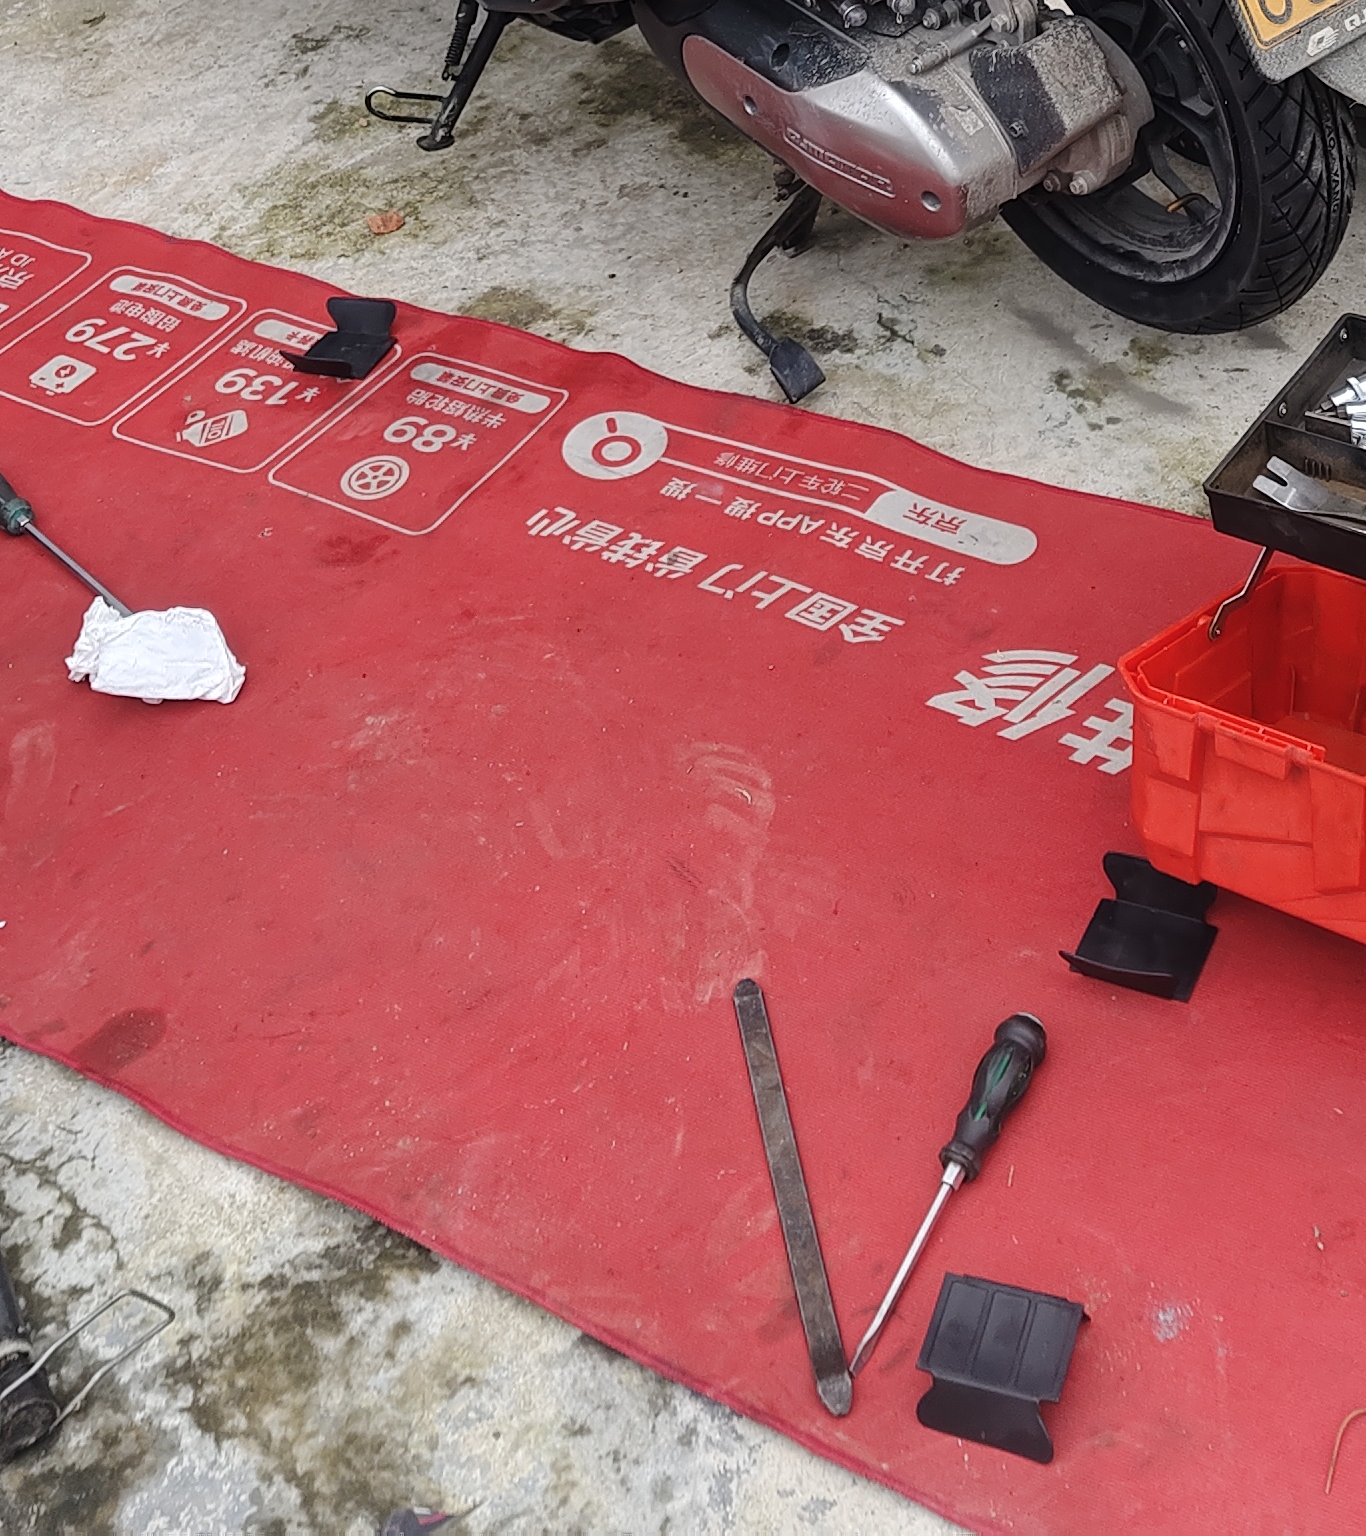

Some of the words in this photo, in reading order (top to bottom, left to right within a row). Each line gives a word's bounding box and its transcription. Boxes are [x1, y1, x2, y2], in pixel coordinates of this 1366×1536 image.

[12, 253, 36, 267] JD
[109, 298, 182, 332] 铅酸电池
[435, 369, 524, 403] 免费上门安装
[405, 388, 508, 430] 半热熔轮胎
[207, 417, 223, 440] OIL
[713, 450, 871, 507] 二轮车上门维修
[902, 501, 966, 535] 京东
[525, 505, 711, 580] 省钱省心
[697, 562, 906, 644] 全国上门
